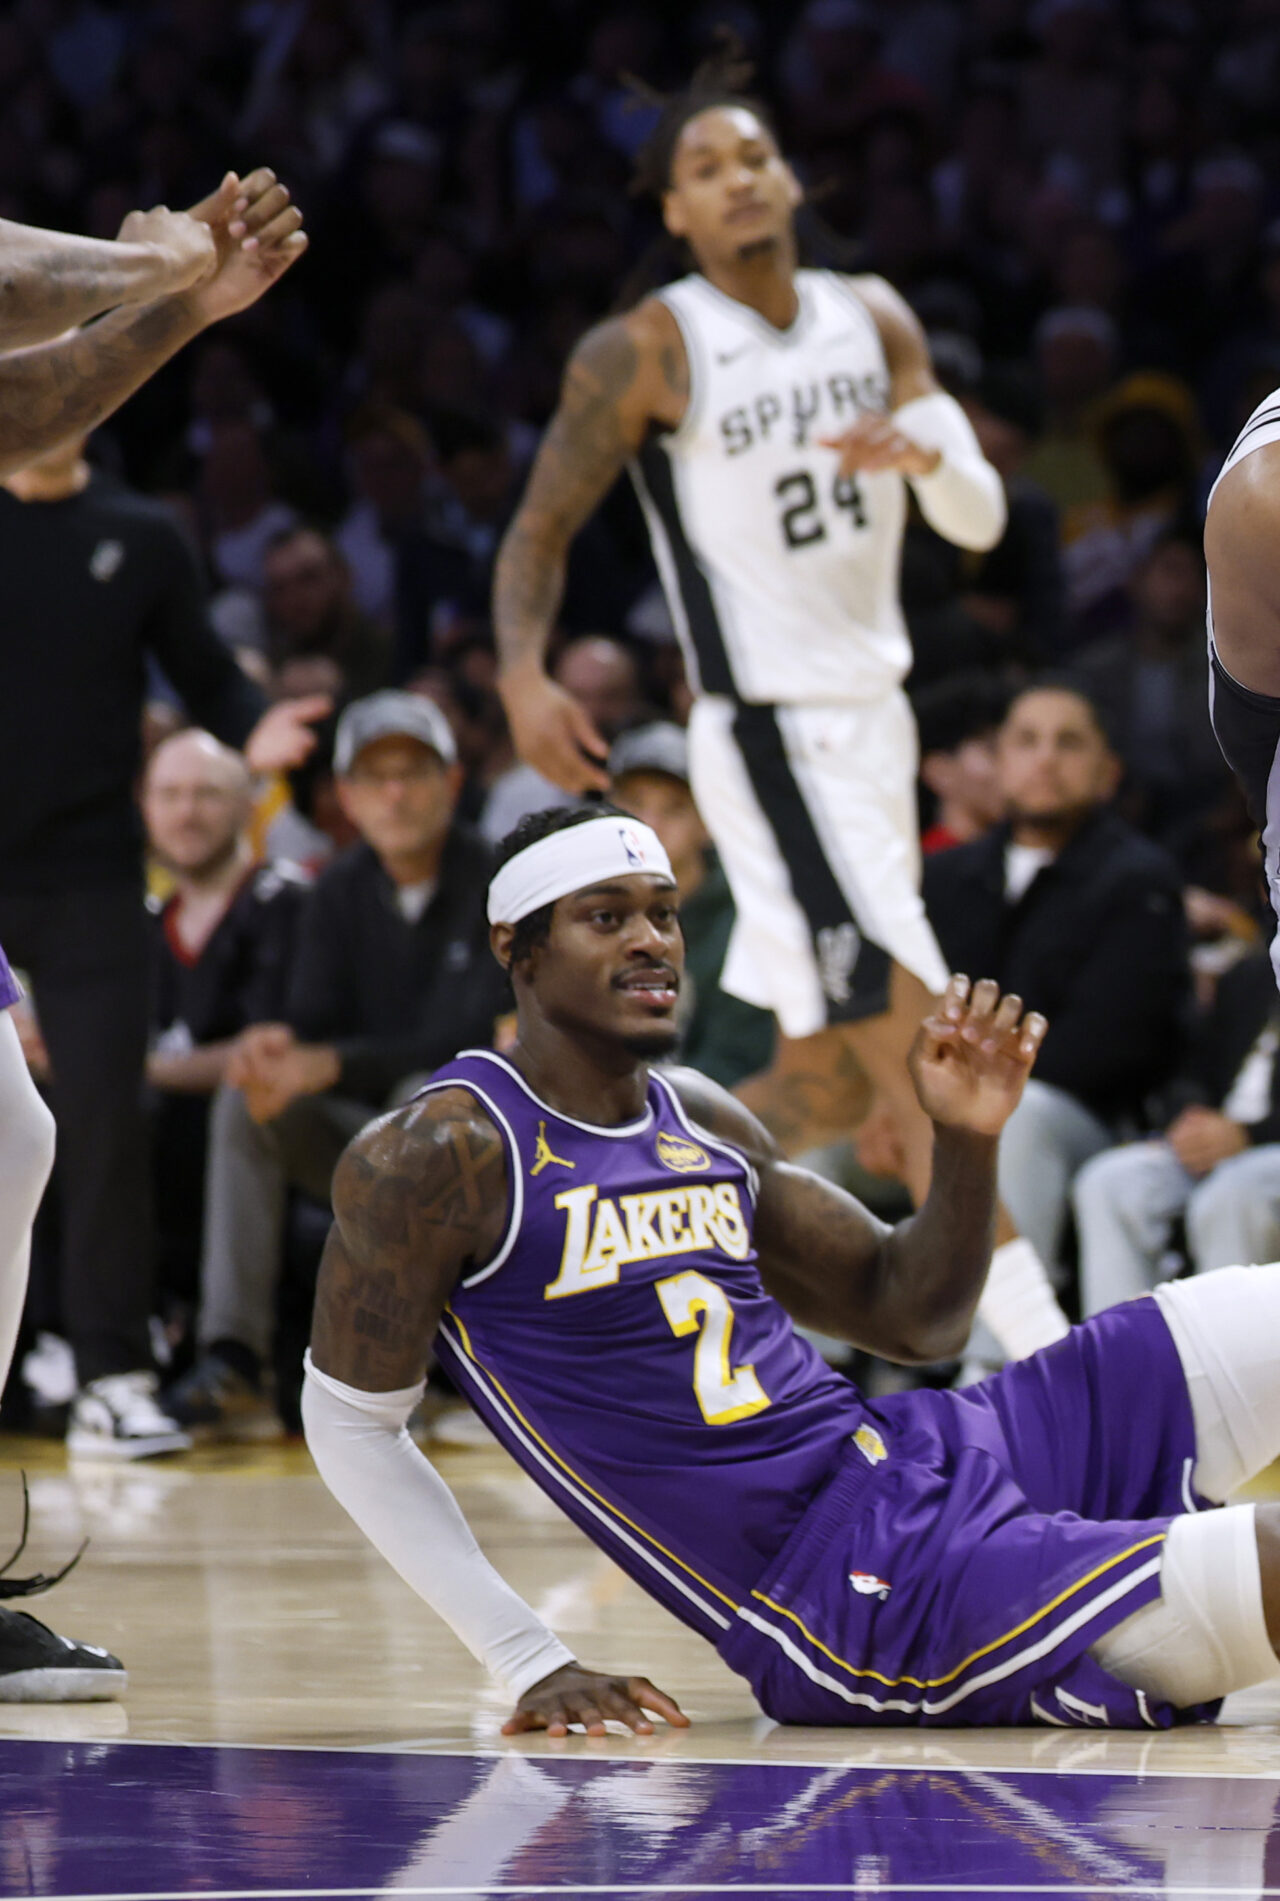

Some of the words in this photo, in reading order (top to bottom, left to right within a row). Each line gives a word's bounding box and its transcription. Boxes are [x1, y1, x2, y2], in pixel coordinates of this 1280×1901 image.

[774, 466, 869, 549] 24
[544, 1181, 750, 1301] LAKERS
[654, 1268, 773, 1427] 2
